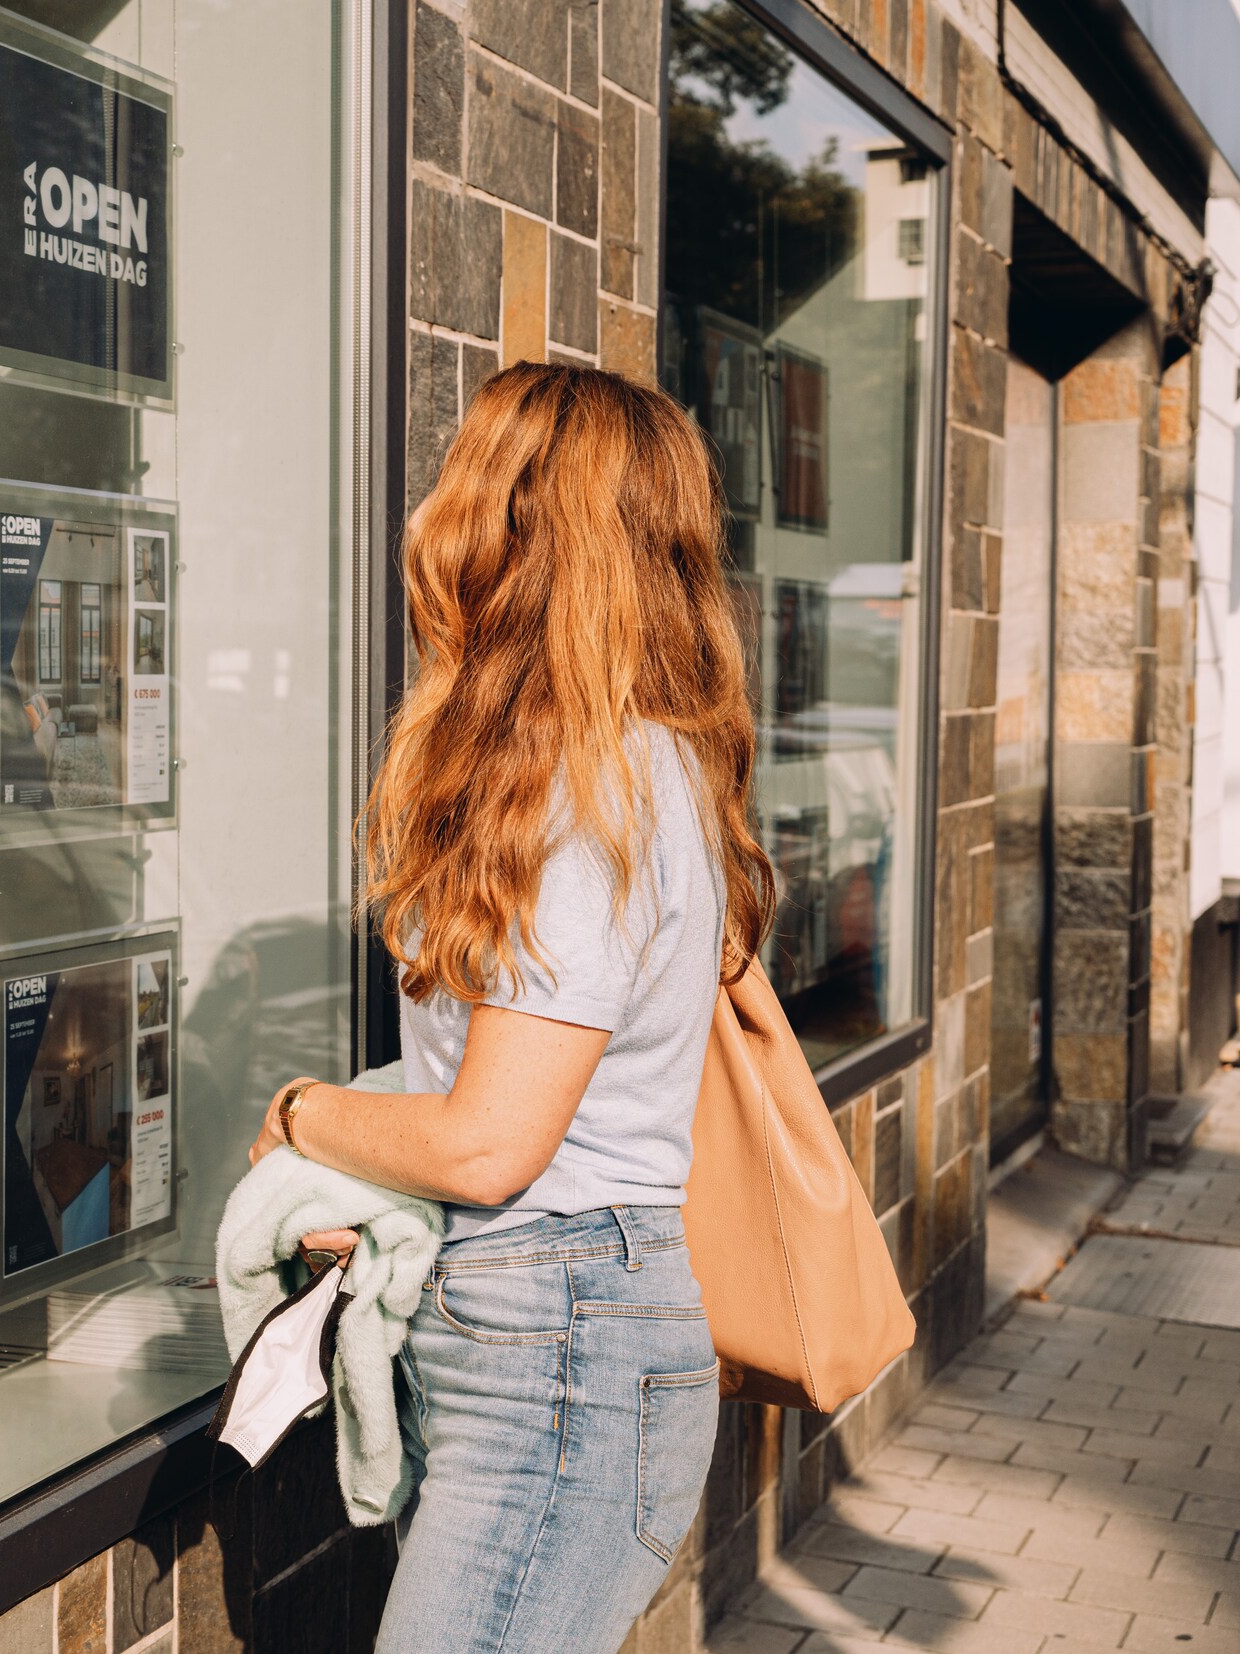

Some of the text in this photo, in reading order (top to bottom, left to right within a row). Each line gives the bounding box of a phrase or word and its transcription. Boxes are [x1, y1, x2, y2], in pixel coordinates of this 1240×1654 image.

[23, 160, 37, 257] ERA
[40, 166, 148, 254] OPEN
[40, 231, 148, 287] HUIZEN DAG
[6, 515, 41, 536] OPEN
[28, 536, 41, 546] DAG
[139, 689, 149, 699] 675
[150, 689, 161, 699] 000
[13, 976, 47, 999] OPEN
[13, 994, 47, 1009] HUIZEN DAG
[152, 1109, 165, 1122] 000
